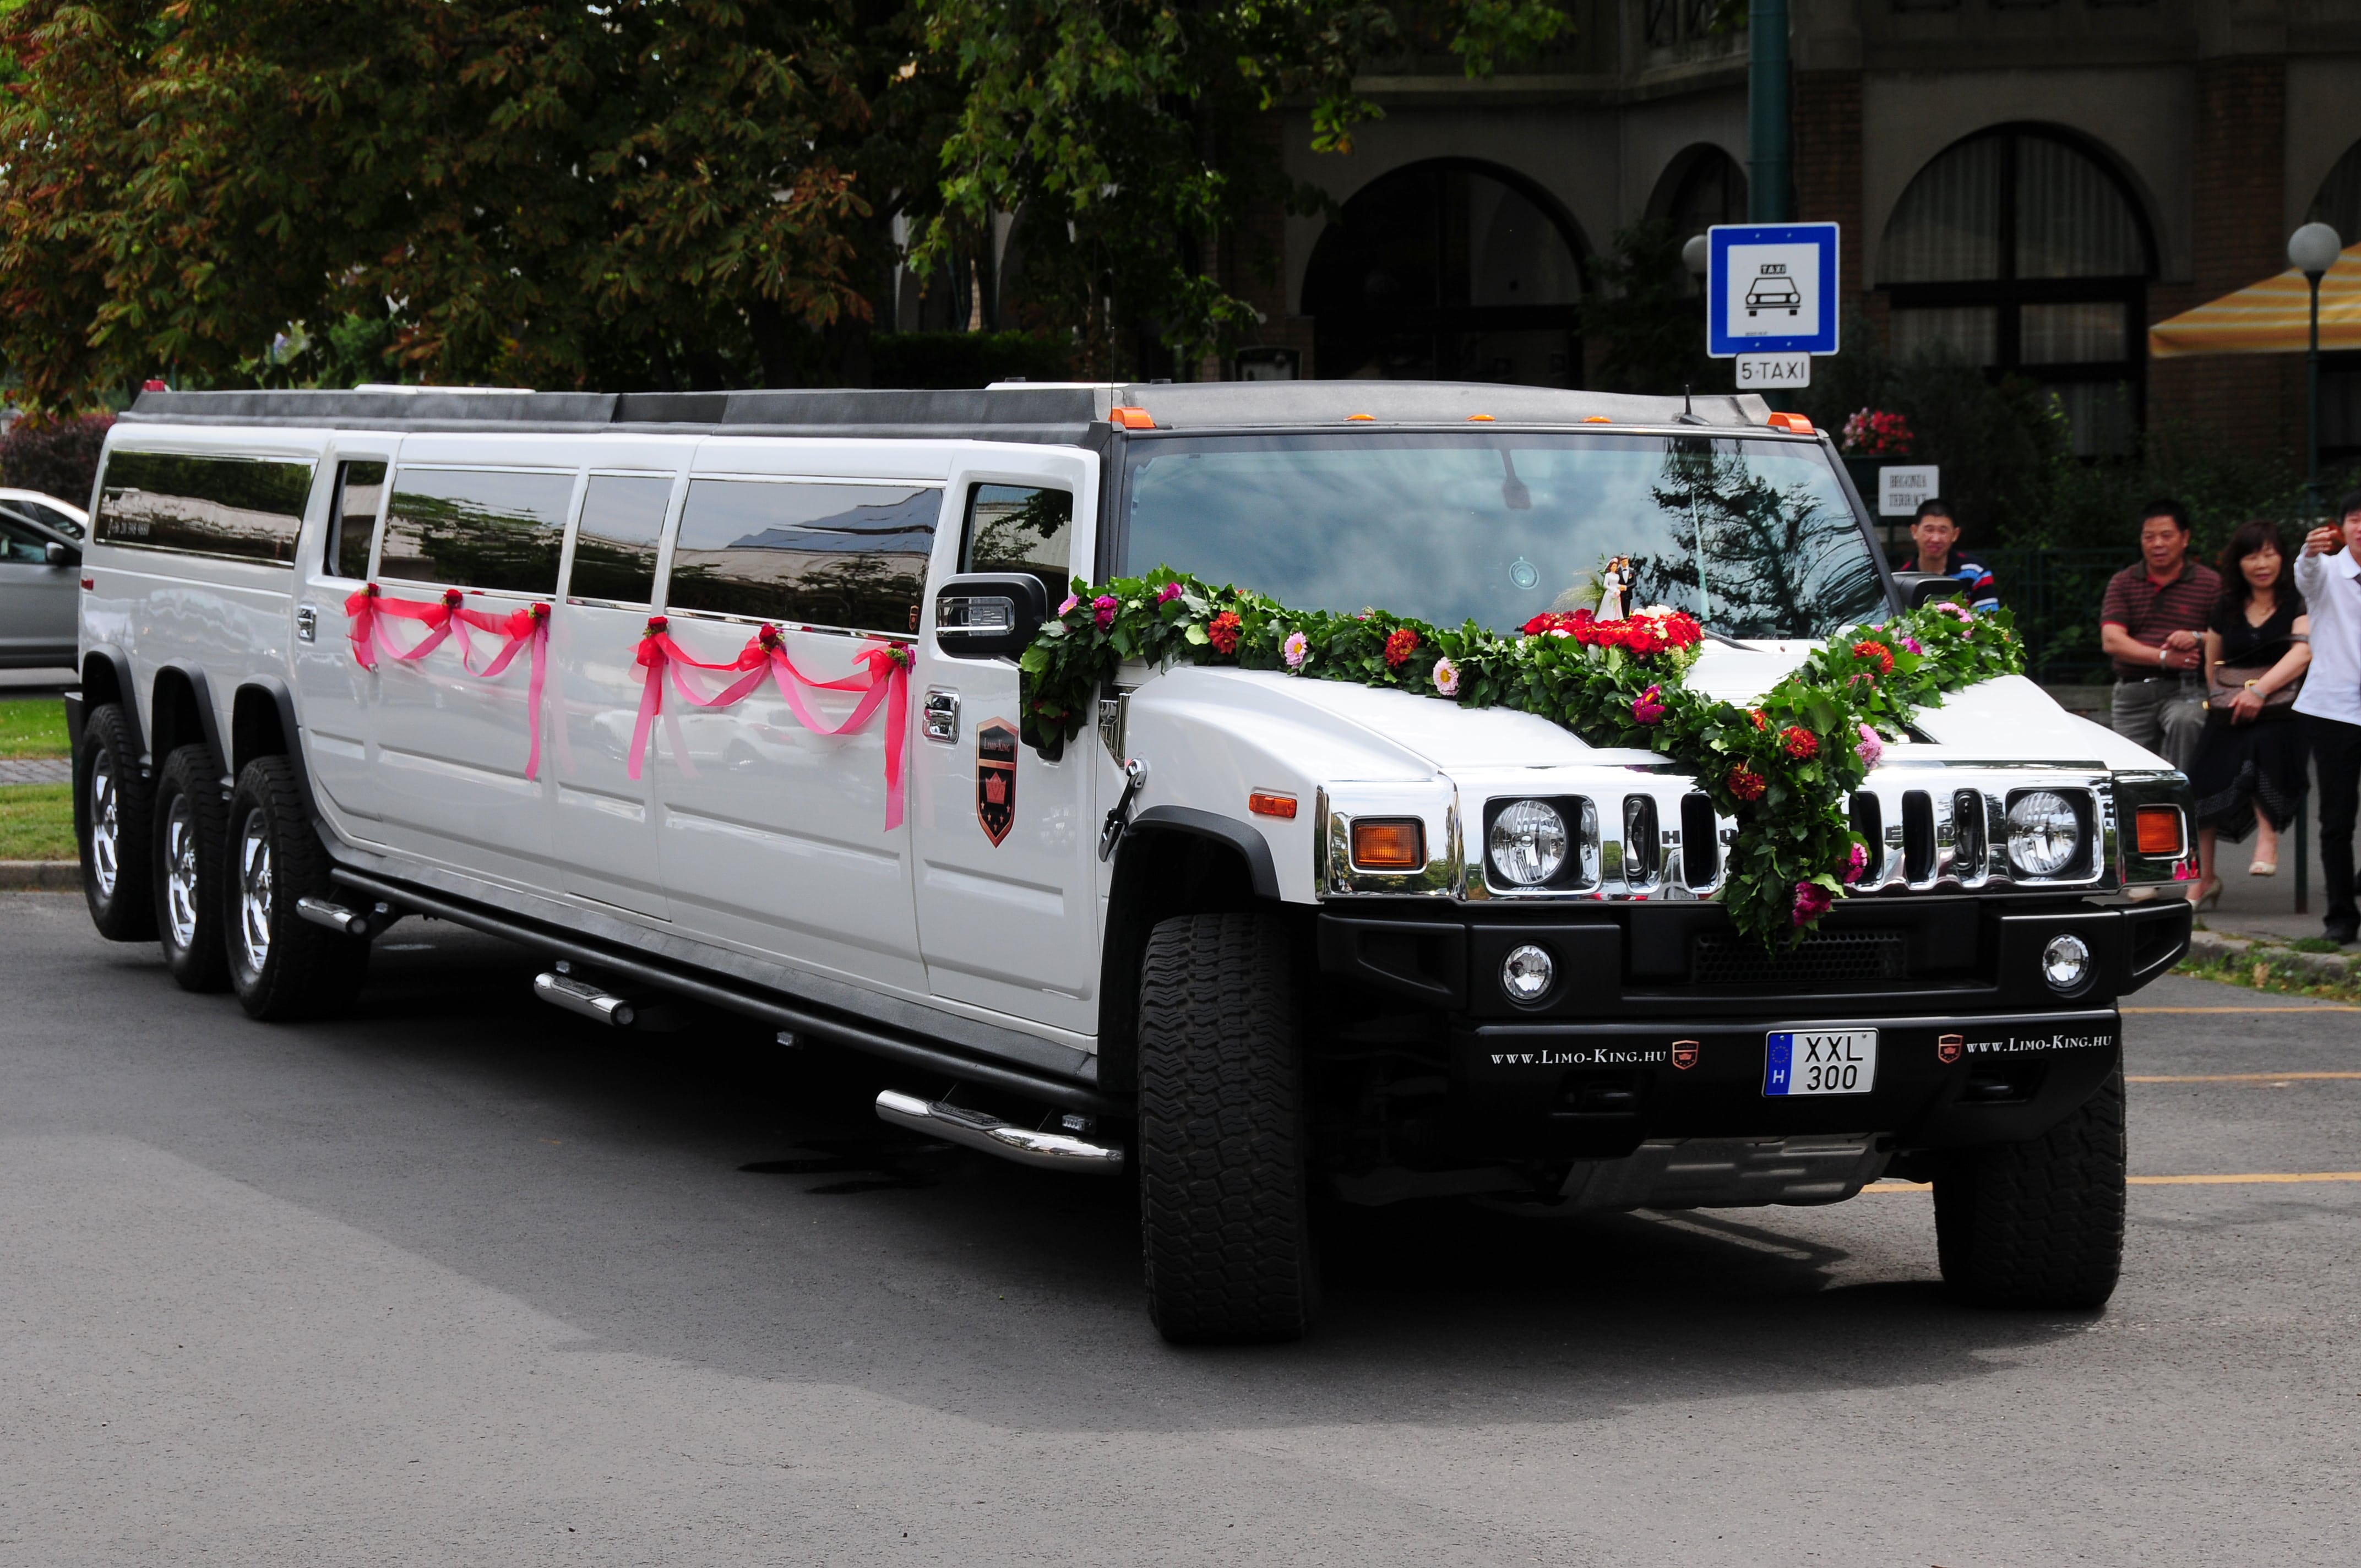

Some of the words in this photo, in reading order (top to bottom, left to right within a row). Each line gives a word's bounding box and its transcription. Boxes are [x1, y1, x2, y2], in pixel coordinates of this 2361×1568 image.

[1762, 265, 1786, 274] TAXI
[1662, 825, 1955, 845] HUER
[1805, 1036, 1863, 1063] XXL
[1772, 1069, 1785, 1084] H
[1807, 1064, 1858, 1091] 300
